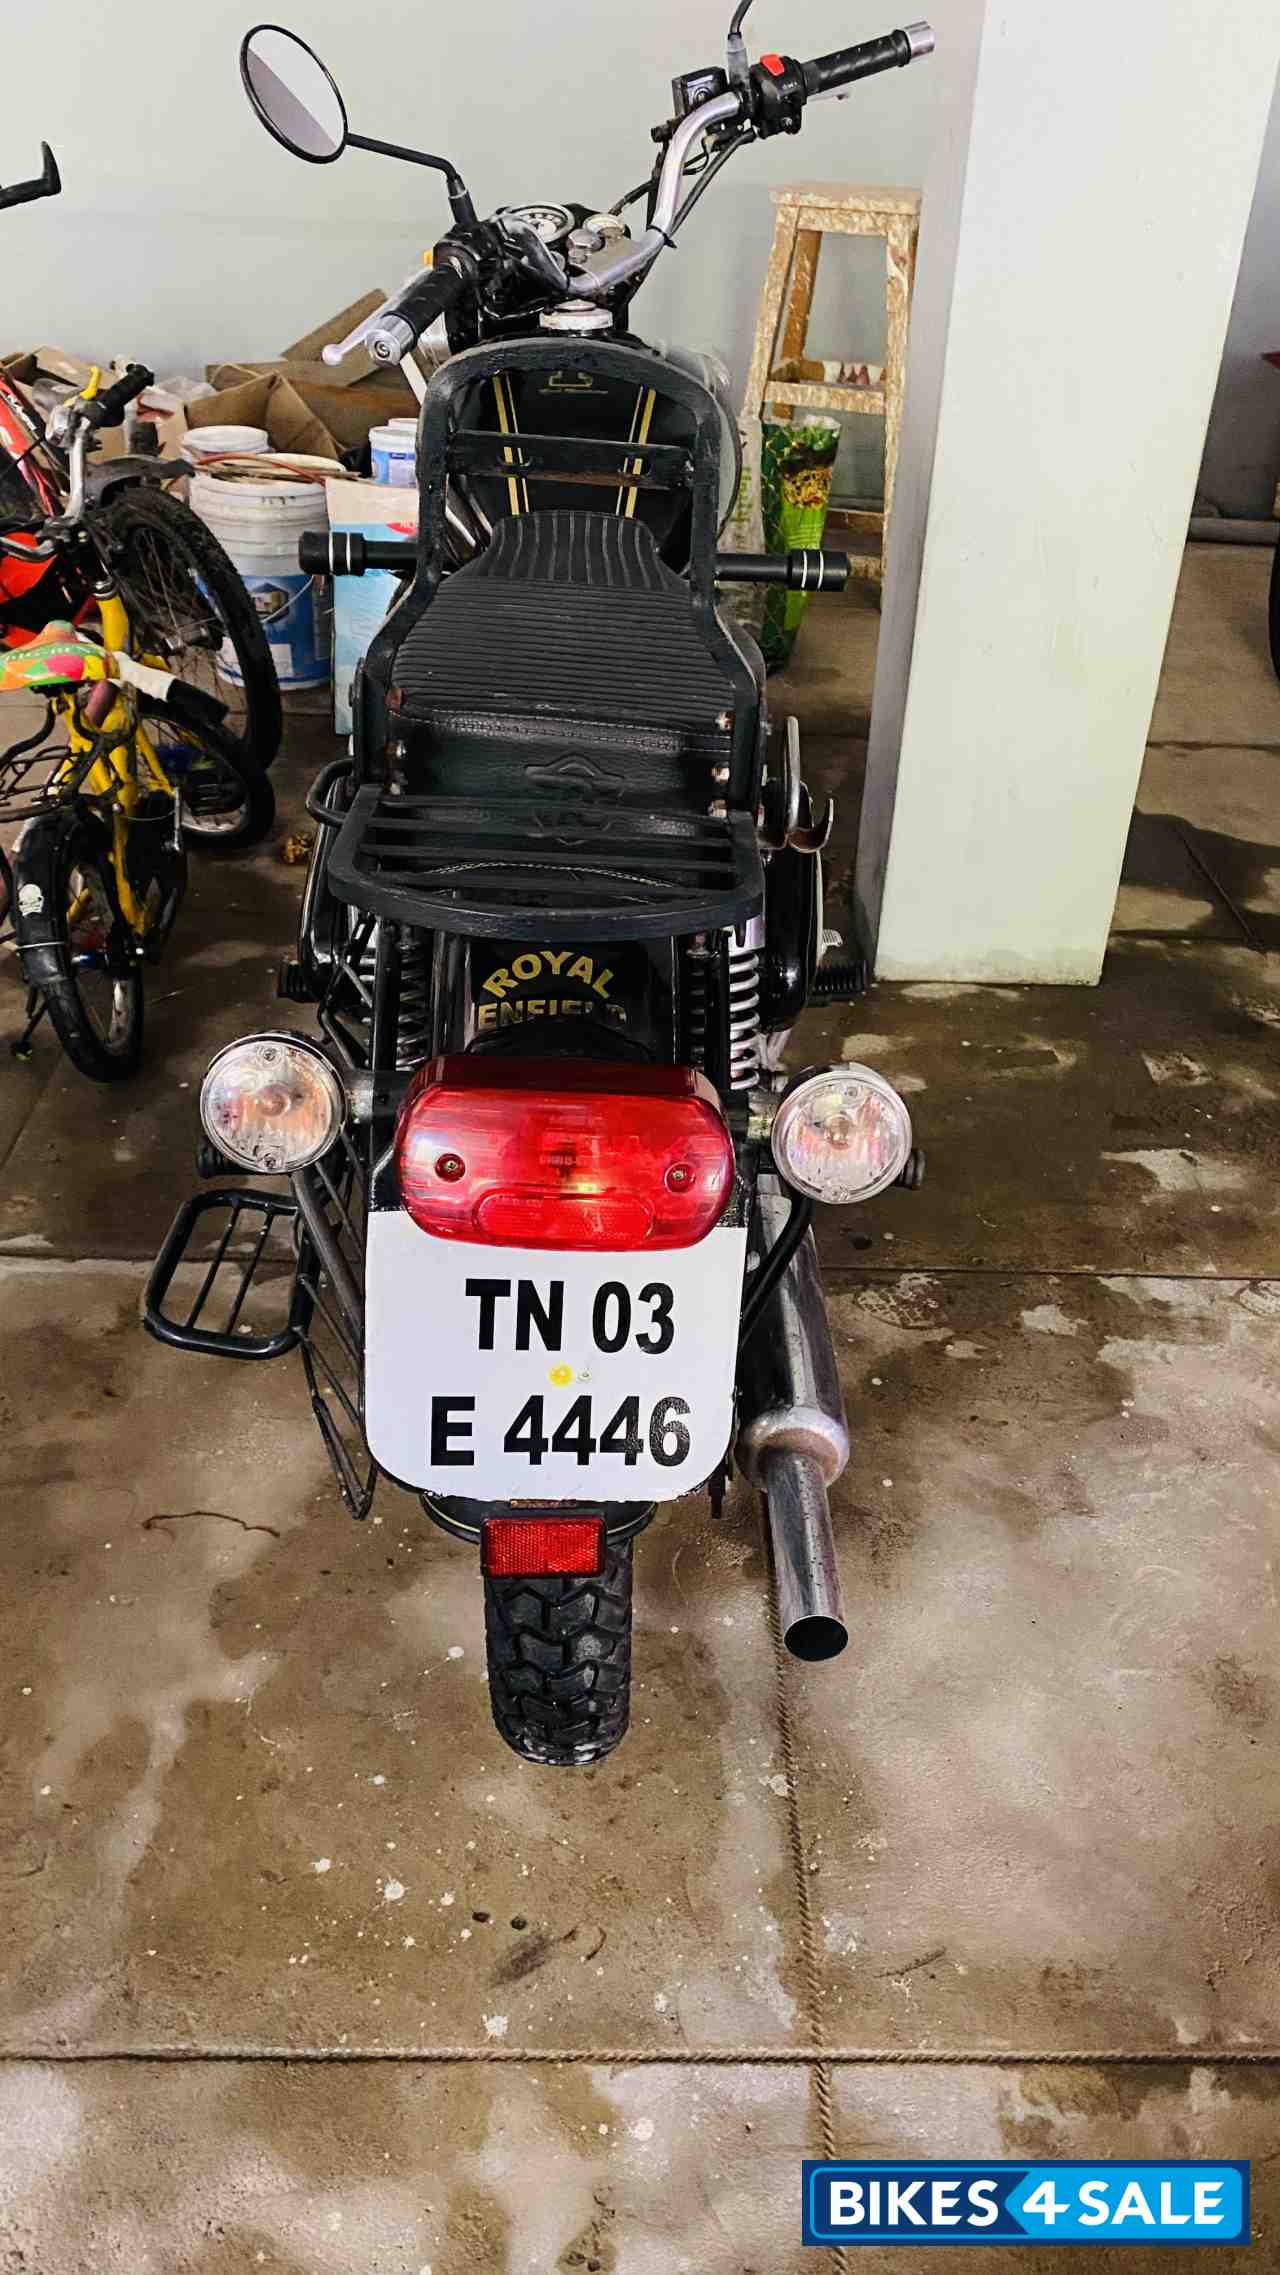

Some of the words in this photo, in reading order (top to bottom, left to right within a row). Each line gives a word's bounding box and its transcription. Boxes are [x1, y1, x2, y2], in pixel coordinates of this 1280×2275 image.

[482, 950, 615, 998] ROYAL
[465, 1278, 565, 1352] TN
[592, 1281, 675, 1355] 03
[430, 1395, 476, 1466] E
[503, 1394, 691, 1467] 4446
